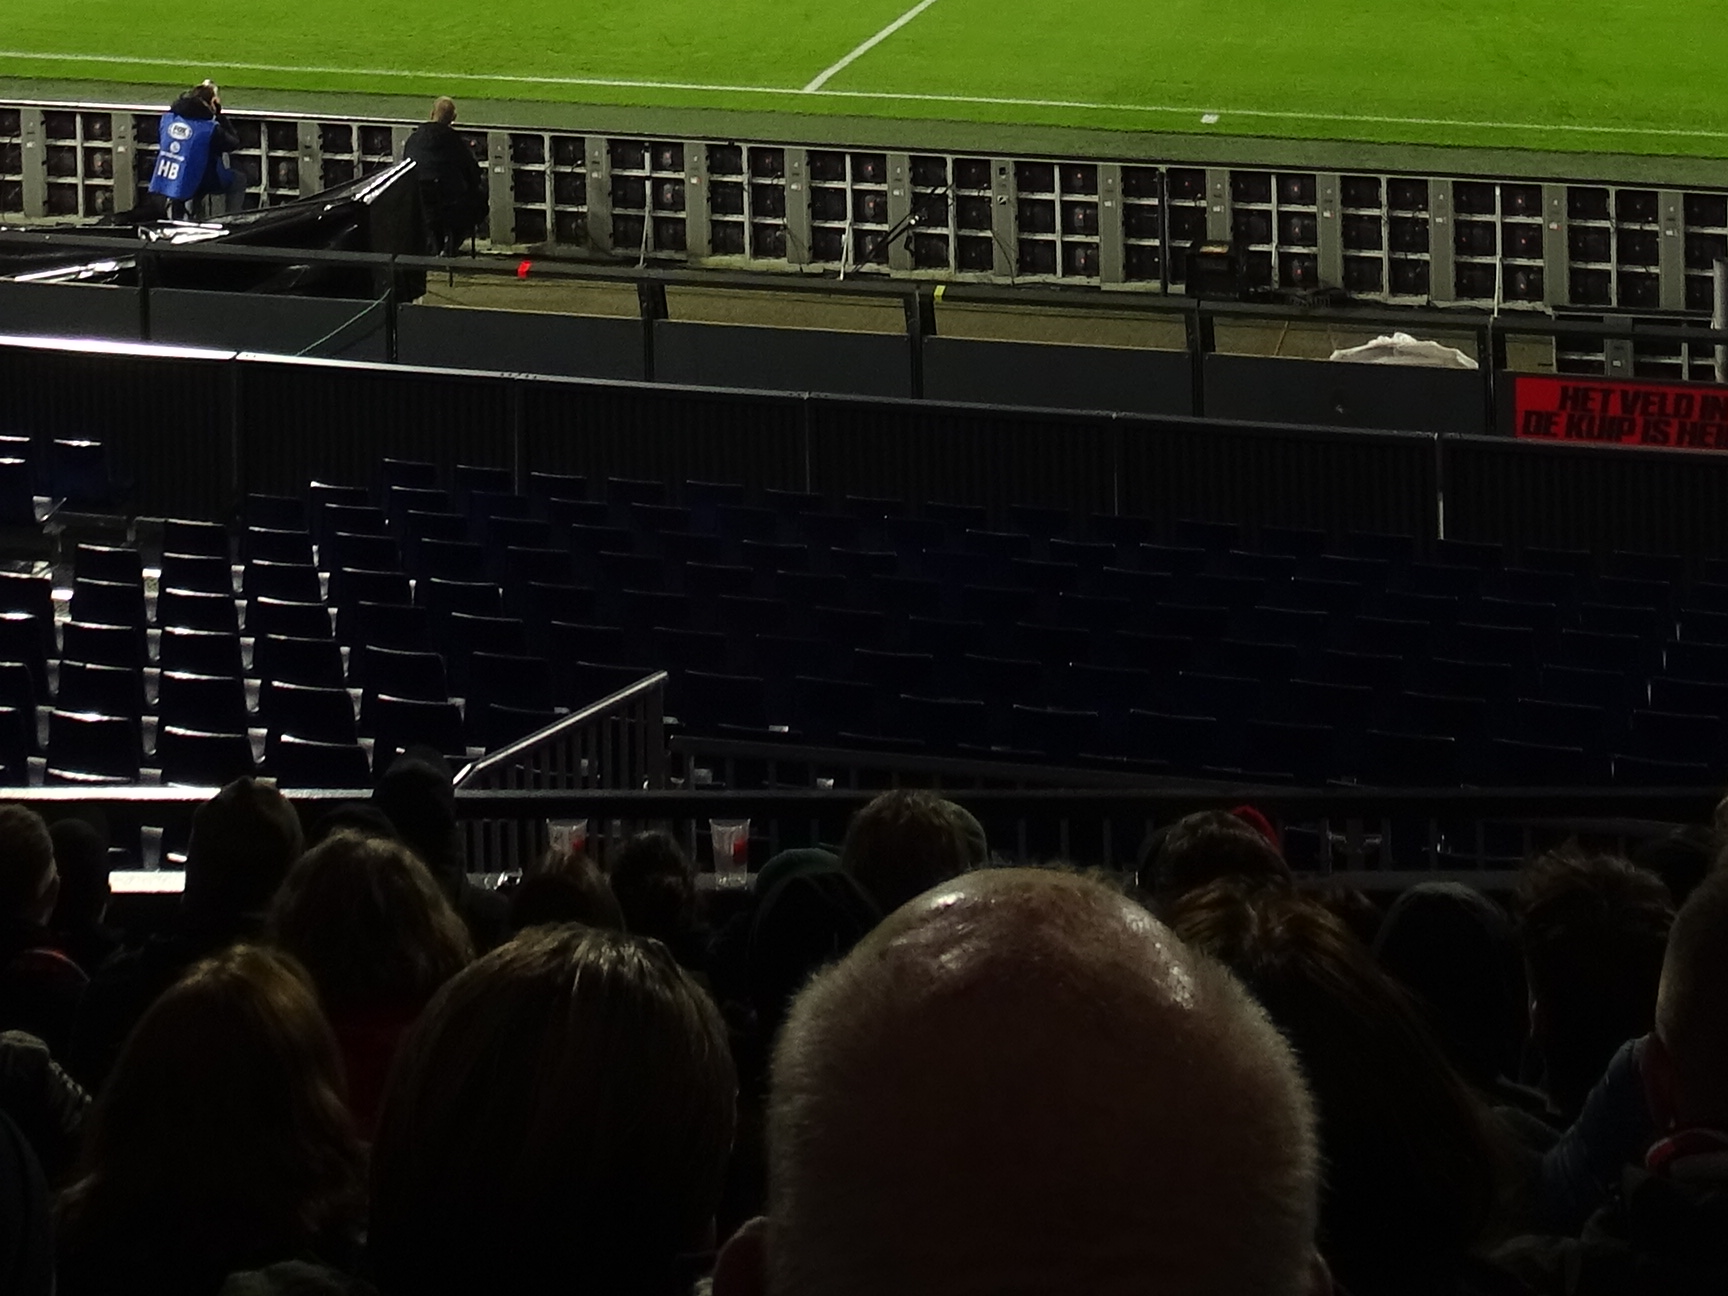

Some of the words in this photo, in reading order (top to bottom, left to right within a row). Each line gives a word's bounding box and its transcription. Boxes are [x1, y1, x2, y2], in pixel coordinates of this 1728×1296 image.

[157, 158, 180, 180] HB
[1559, 386, 1615, 412] HET
[1620, 389, 1694, 419] VELD
[1522, 410, 1561, 437] DE
[1565, 412, 1637, 442] KUIP
[1641, 418, 1672, 444] IS
